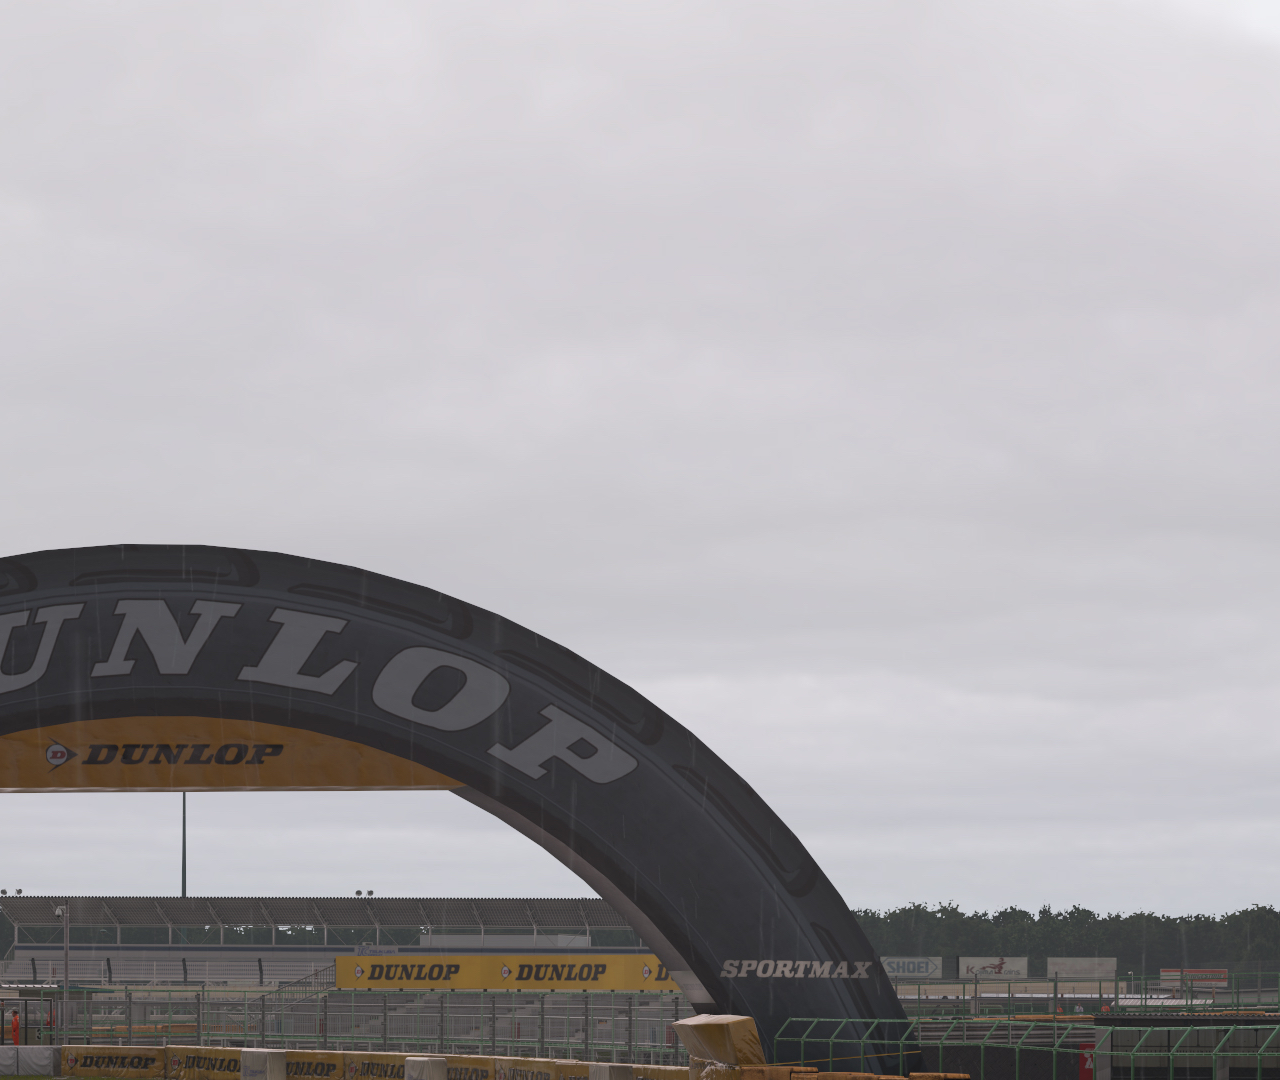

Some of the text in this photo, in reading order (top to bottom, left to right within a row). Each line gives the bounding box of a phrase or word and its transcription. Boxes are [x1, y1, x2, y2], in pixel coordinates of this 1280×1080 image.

[81, 743, 284, 765] DUNLOP
[367, 964, 460, 981] DUNLOP
[515, 964, 607, 981] DUNLOP
[720, 959, 872, 979] SPORTMAX
[886, 961, 930, 974] SHOEI
[80, 1055, 156, 1070] DUNLOP
[184, 1055, 241, 1072] DUNLO
[286, 1062, 336, 1078] UNLOP
[359, 1062, 405, 1079] DUNLO
